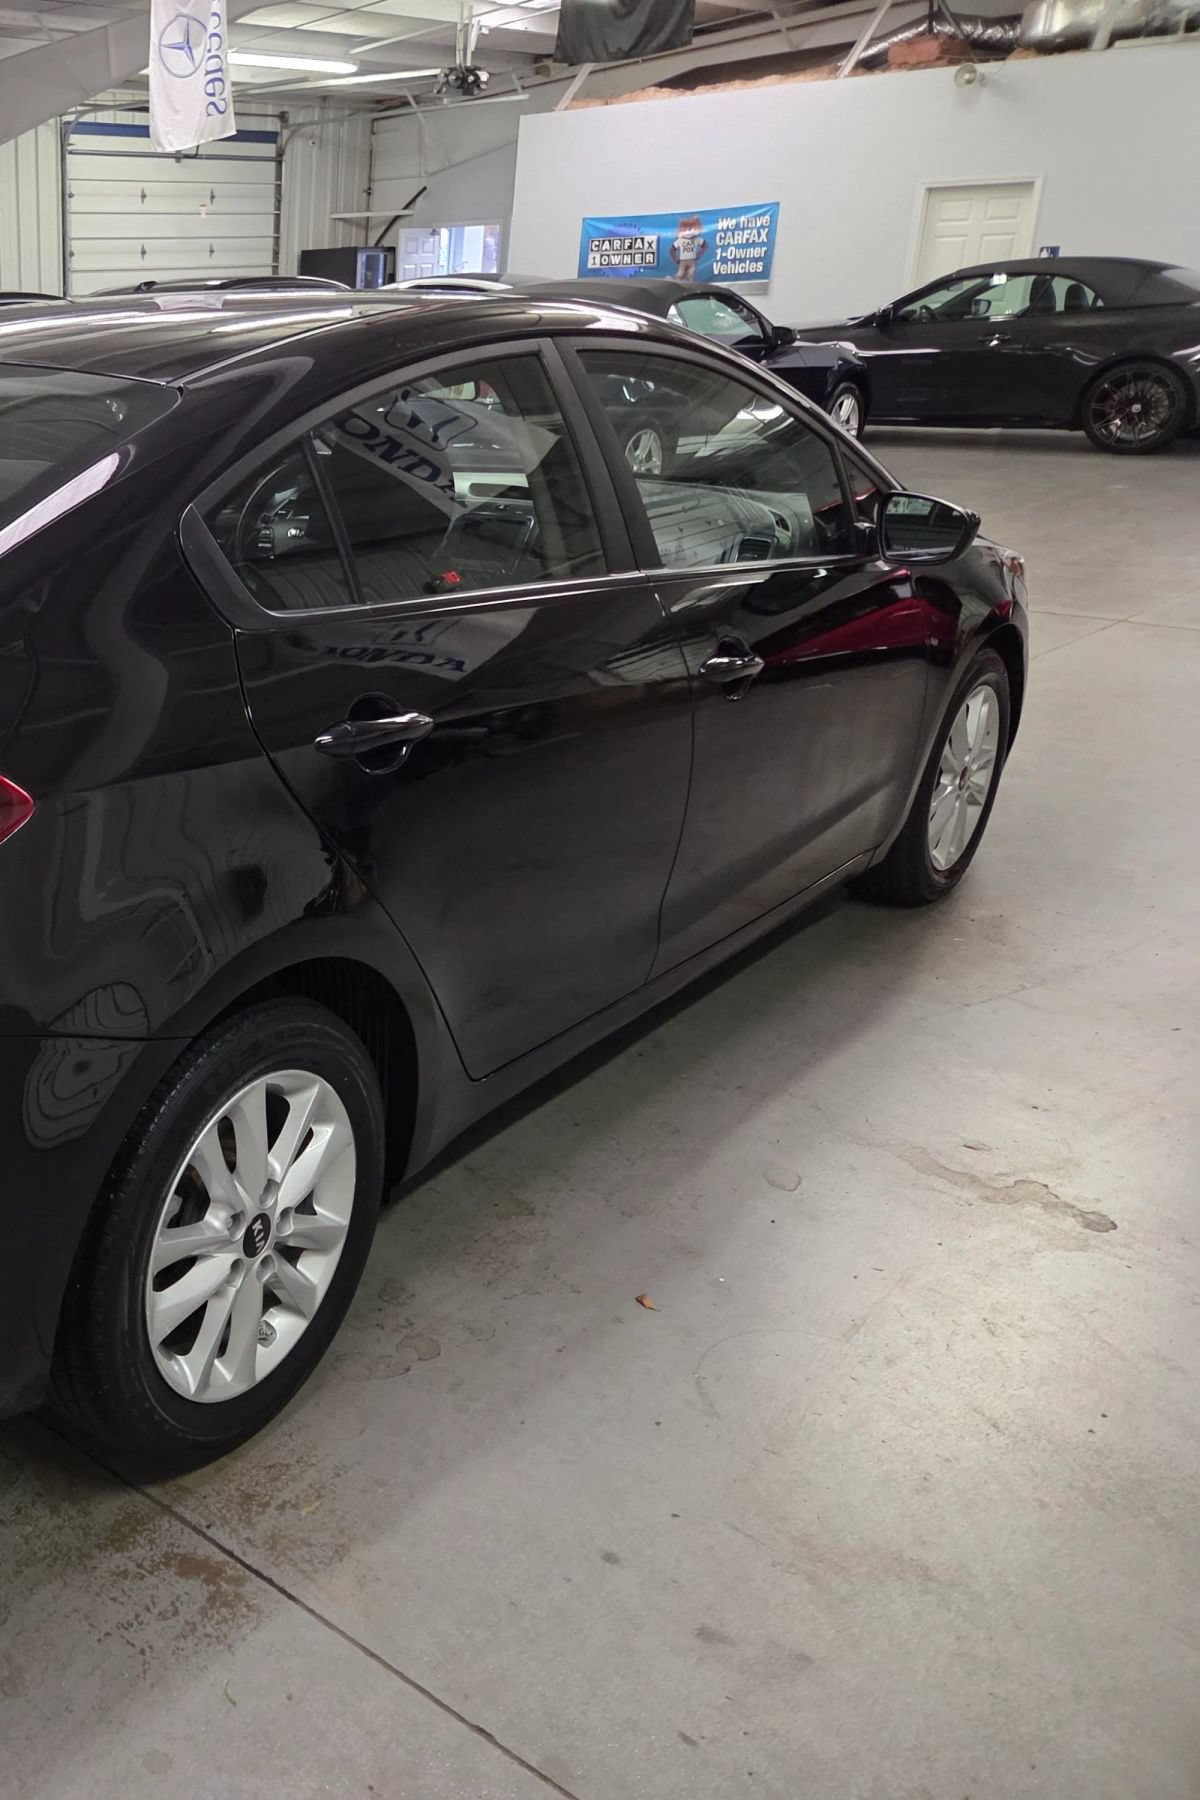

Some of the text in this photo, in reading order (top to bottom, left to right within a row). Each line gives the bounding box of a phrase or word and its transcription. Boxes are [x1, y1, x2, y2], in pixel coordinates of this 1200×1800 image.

[718, 214, 771, 230] We have
[591, 238, 654, 252] CARFAX
[716, 228, 769, 246] CARFAX
[716, 246, 768, 261] 1-Owner
[713, 259, 764, 275] Vehicles
